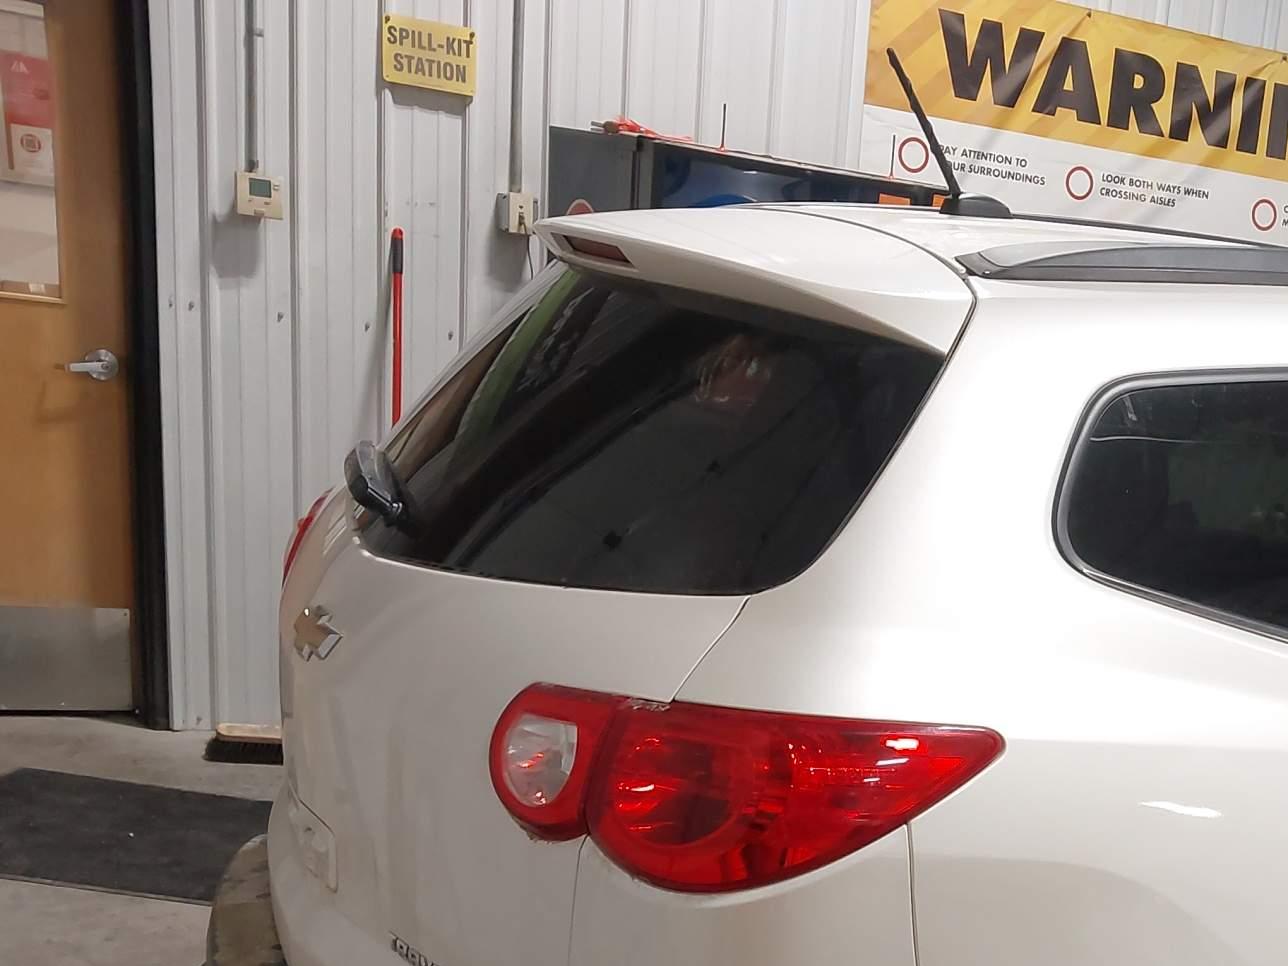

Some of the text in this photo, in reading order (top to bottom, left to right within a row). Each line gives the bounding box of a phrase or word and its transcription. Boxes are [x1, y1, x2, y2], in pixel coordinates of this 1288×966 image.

[387, 25, 473, 58] SPILL-KIT
[393, 52, 466, 83] STATION
[961, 149, 1013, 165] ATTENTION
[1015, 157, 1028, 168] TO
[967, 163, 1046, 186] SURROUNDINGS
[1102, 173, 1209, 199] LOOK BOTH WAYS WHEN
[1100, 187, 1176, 208] CROSSING AISLES
